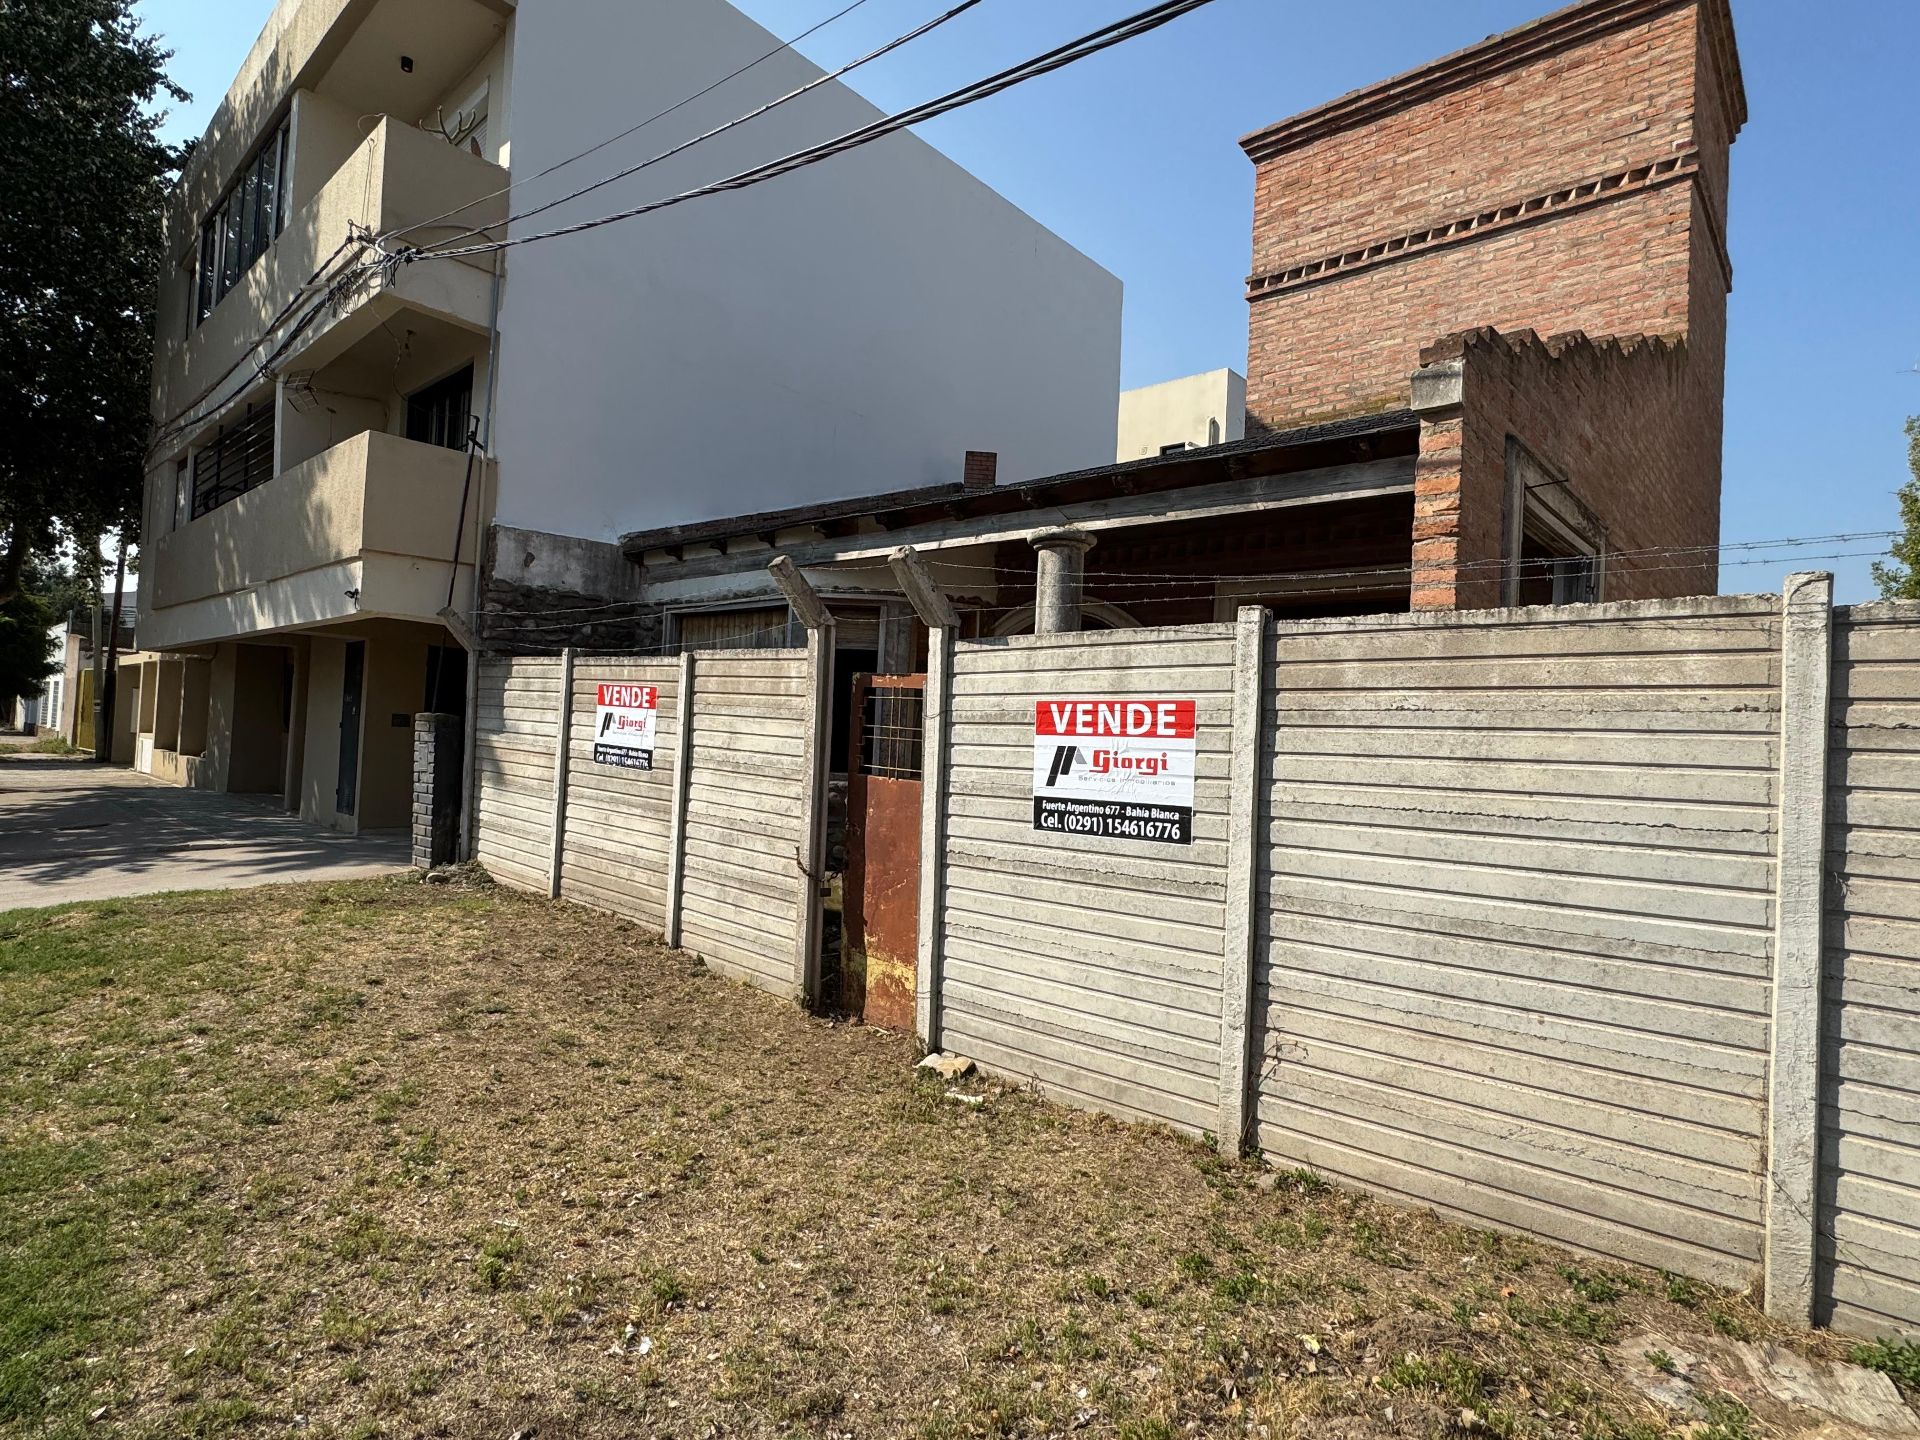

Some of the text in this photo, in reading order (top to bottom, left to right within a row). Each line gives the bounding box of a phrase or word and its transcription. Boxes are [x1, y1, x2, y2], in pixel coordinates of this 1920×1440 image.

[602, 685, 651, 708] VENDE
[617, 715, 646, 731] Giorgi
[1050, 703, 1177, 736] VENDE
[1088, 749, 1169, 776] Giorgi
[1042, 800, 1066, 811] Fuerte
[1066, 802, 1104, 815] Argentino
[1105, 805, 1120, 816] 677
[1126, 806, 1150, 818] Bahía
[1151, 808, 1180, 820] Blanca
[1040, 812, 1181, 840] Cel. (0291) 154616776
